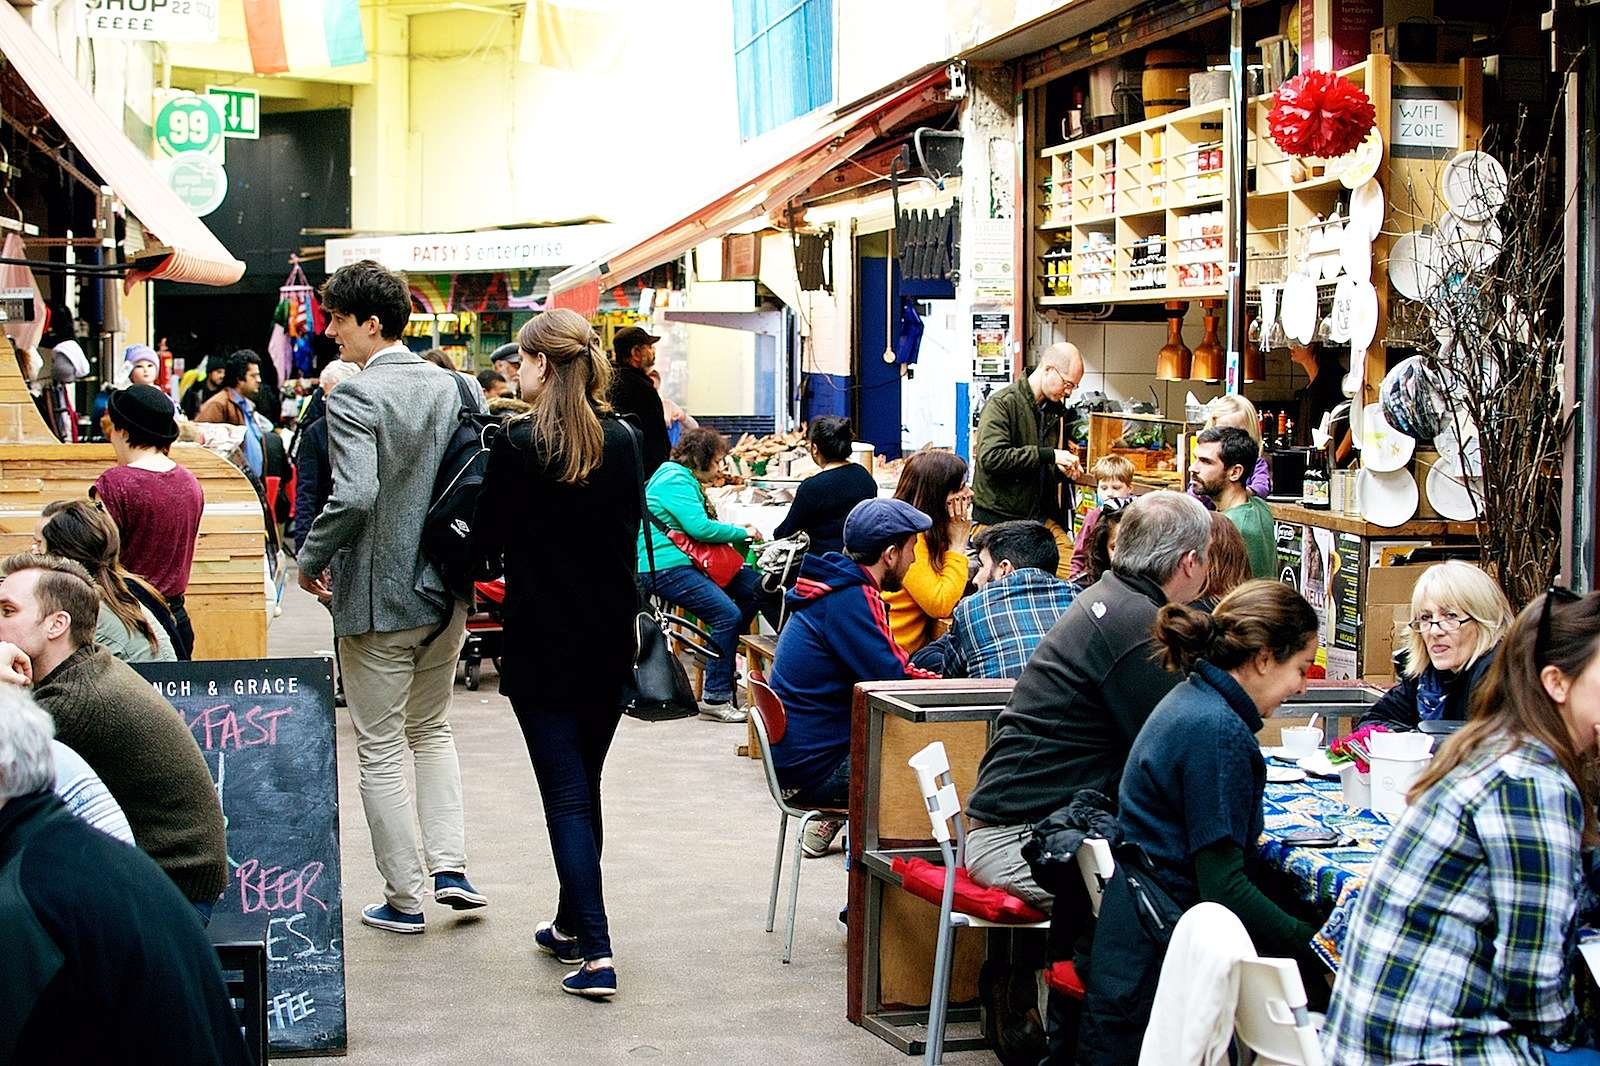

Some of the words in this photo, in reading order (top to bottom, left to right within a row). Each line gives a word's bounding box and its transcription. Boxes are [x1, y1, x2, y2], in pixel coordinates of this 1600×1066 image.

[168, 110, 209, 145] 99
[1399, 104, 1438, 120] WIFI
[1401, 123, 1445, 138] ZONE
[152, 681, 191, 697] NCH
[234, 677, 299, 696] GRACE
[188, 704, 294, 751] FAST
[236, 858, 327, 914] BEER
[266, 912, 316, 961] ES
